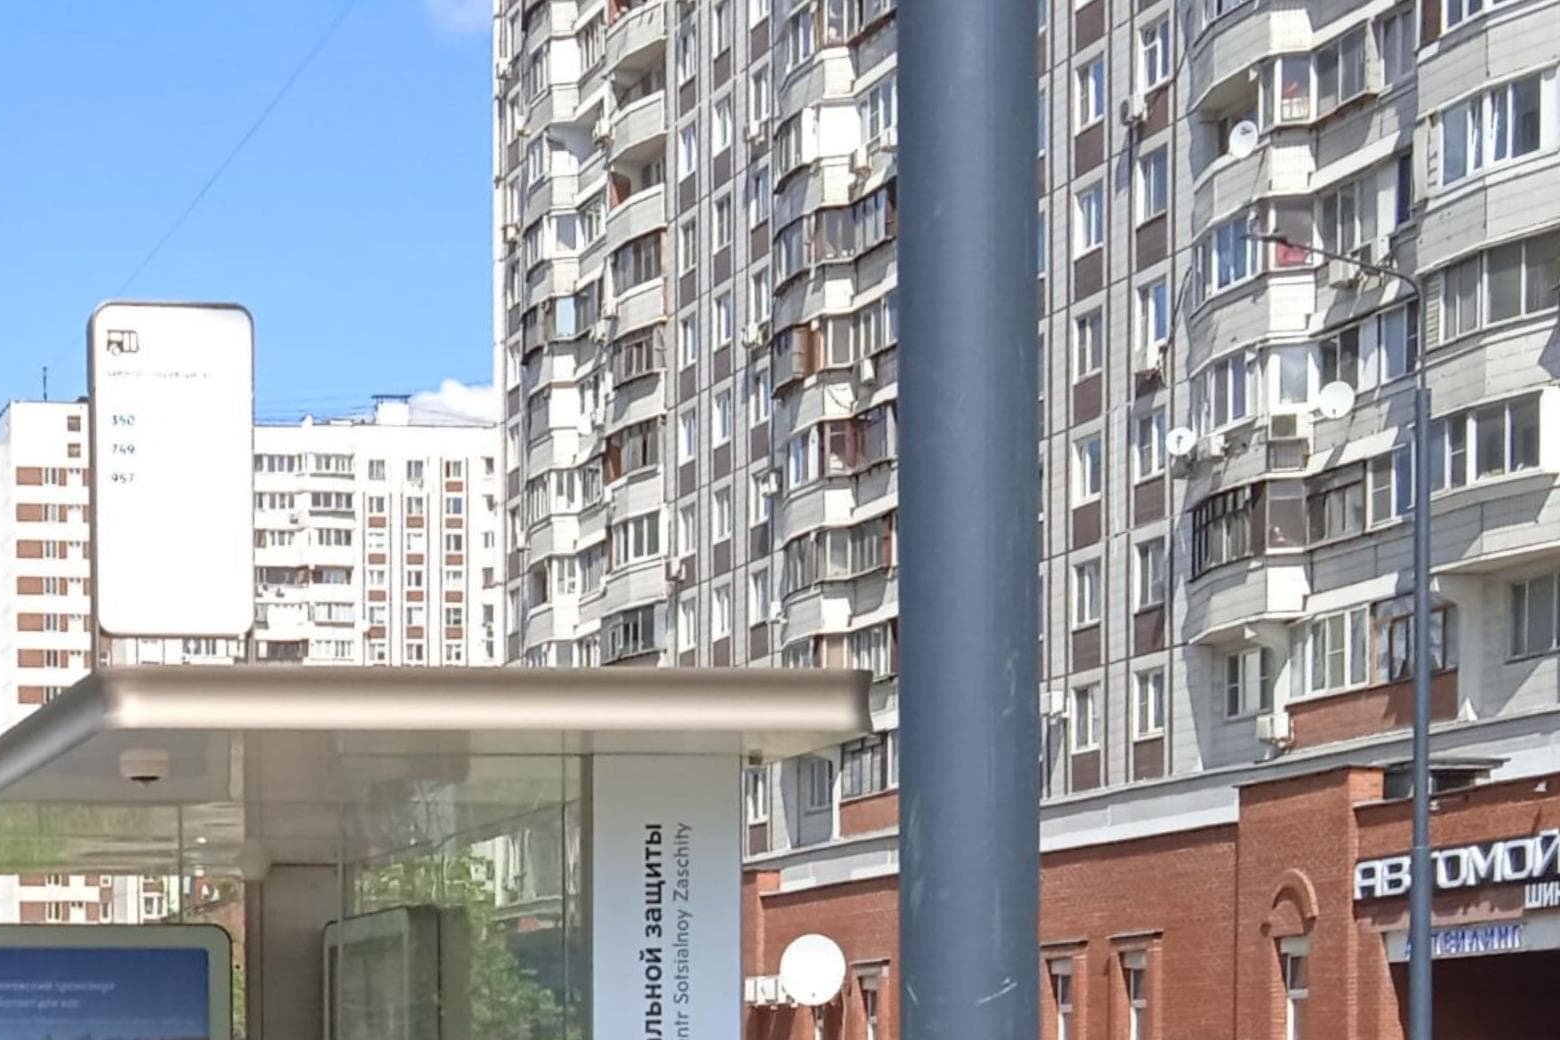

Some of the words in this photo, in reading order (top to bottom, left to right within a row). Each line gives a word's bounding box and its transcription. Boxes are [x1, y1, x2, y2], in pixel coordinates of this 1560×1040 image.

[644, 823, 666, 939] защиты
[672, 822, 693, 902] Zaschity
[1353, 827, 1560, 900] АВОМОЙ
[672, 908, 693, 1005] Sotsialnoy
